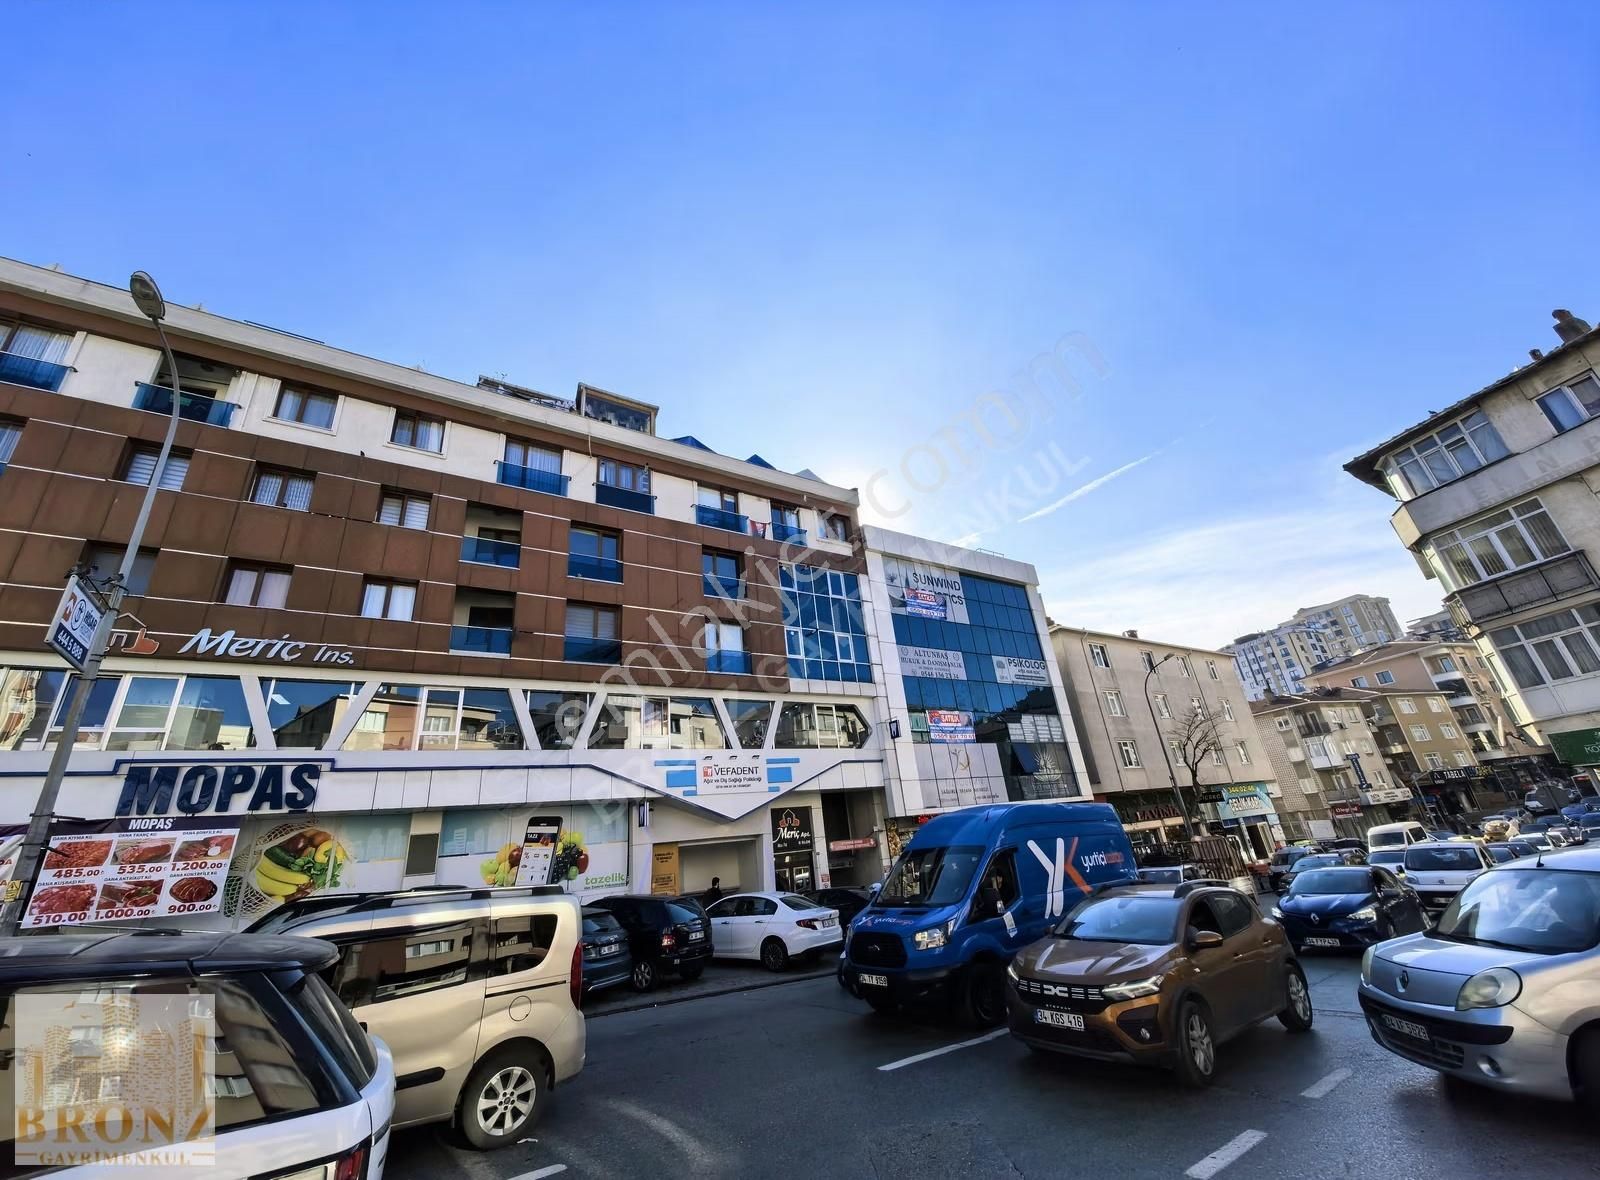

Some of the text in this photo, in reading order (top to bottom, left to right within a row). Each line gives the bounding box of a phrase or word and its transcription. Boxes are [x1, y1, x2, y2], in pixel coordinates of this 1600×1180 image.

[912, 572, 961, 591] SUNWIND
[176, 628, 307, 662] Meriç
[713, 766, 760, 776] VEFADENT
[117, 864, 163, 874] 535.00
[171, 861, 223, 872] 1.200.00
[52, 868, 100, 879] 485.00
[584, 872, 626, 886] tazelik
[95, 908, 151, 921] 1.000.00
[167, 903, 212, 914] 900.00
[32, 911, 88, 925] 510.00
[1038, 1010, 1083, 1028] 34 KGS 416
